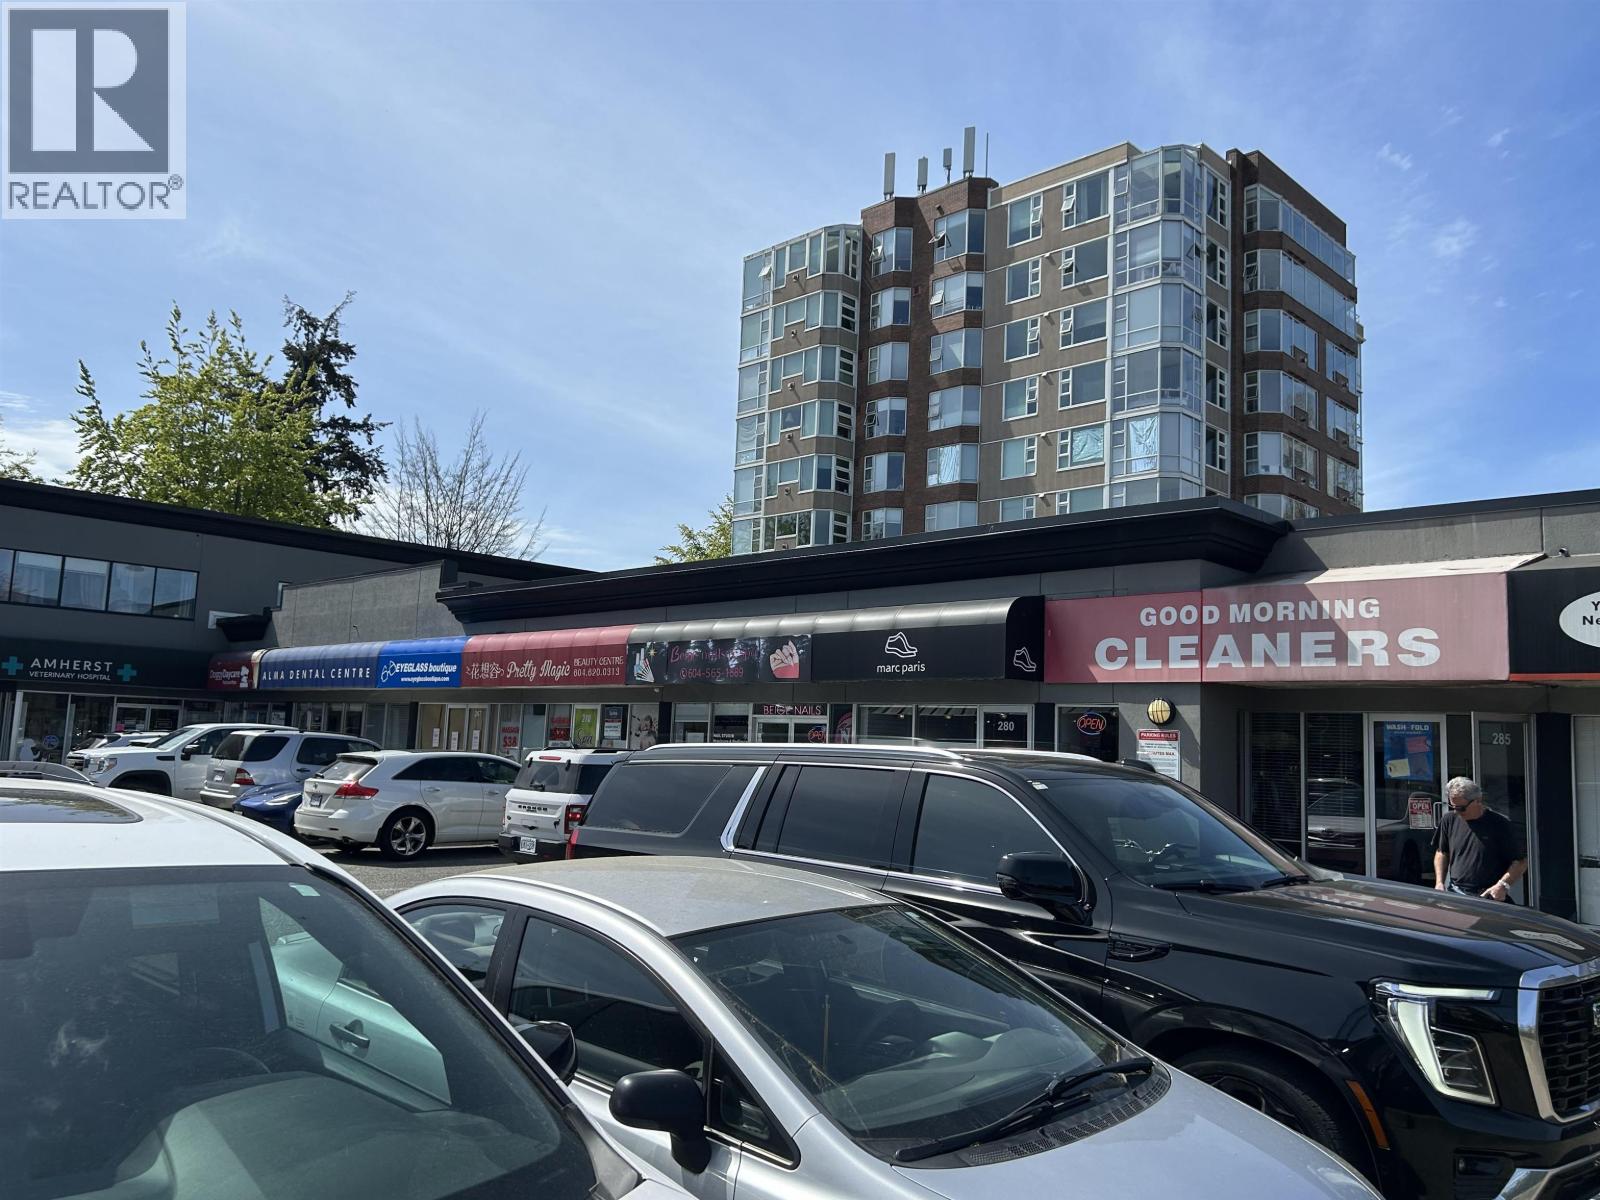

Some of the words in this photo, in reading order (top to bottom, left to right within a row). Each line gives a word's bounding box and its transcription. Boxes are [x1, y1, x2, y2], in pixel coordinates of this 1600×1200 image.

[1140, 605, 1220, 626] GOOD
[1229, 598, 1380, 624] MORNING
[1094, 627, 1442, 671] CLEANERS
[30, 658, 113, 672] AMHERST
[573, 657, 597, 667] BEAUTY
[599, 656, 625, 666] CENTRE
[876, 663, 900, 674] marc
[901, 661, 926, 675] paris
[262, 671, 285, 680] ALMA
[289, 669, 325, 680] DENTAL
[330, 667, 371, 679] CENTRE
[395, 663, 428, 673] EYEGLASS
[428, 662, 457, 675] boutique
[506, 659, 537, 681] Pretty
[539, 659, 571, 681] Magic
[29, 671, 75, 679] VETERINARY
[77, 673, 111, 681] HOSPITAL
[794, 705, 822, 715] NAILS
[997, 721, 1015, 731] 280
[1078, 718, 1104, 730] OPEN
[1492, 733, 1511, 745] 285
